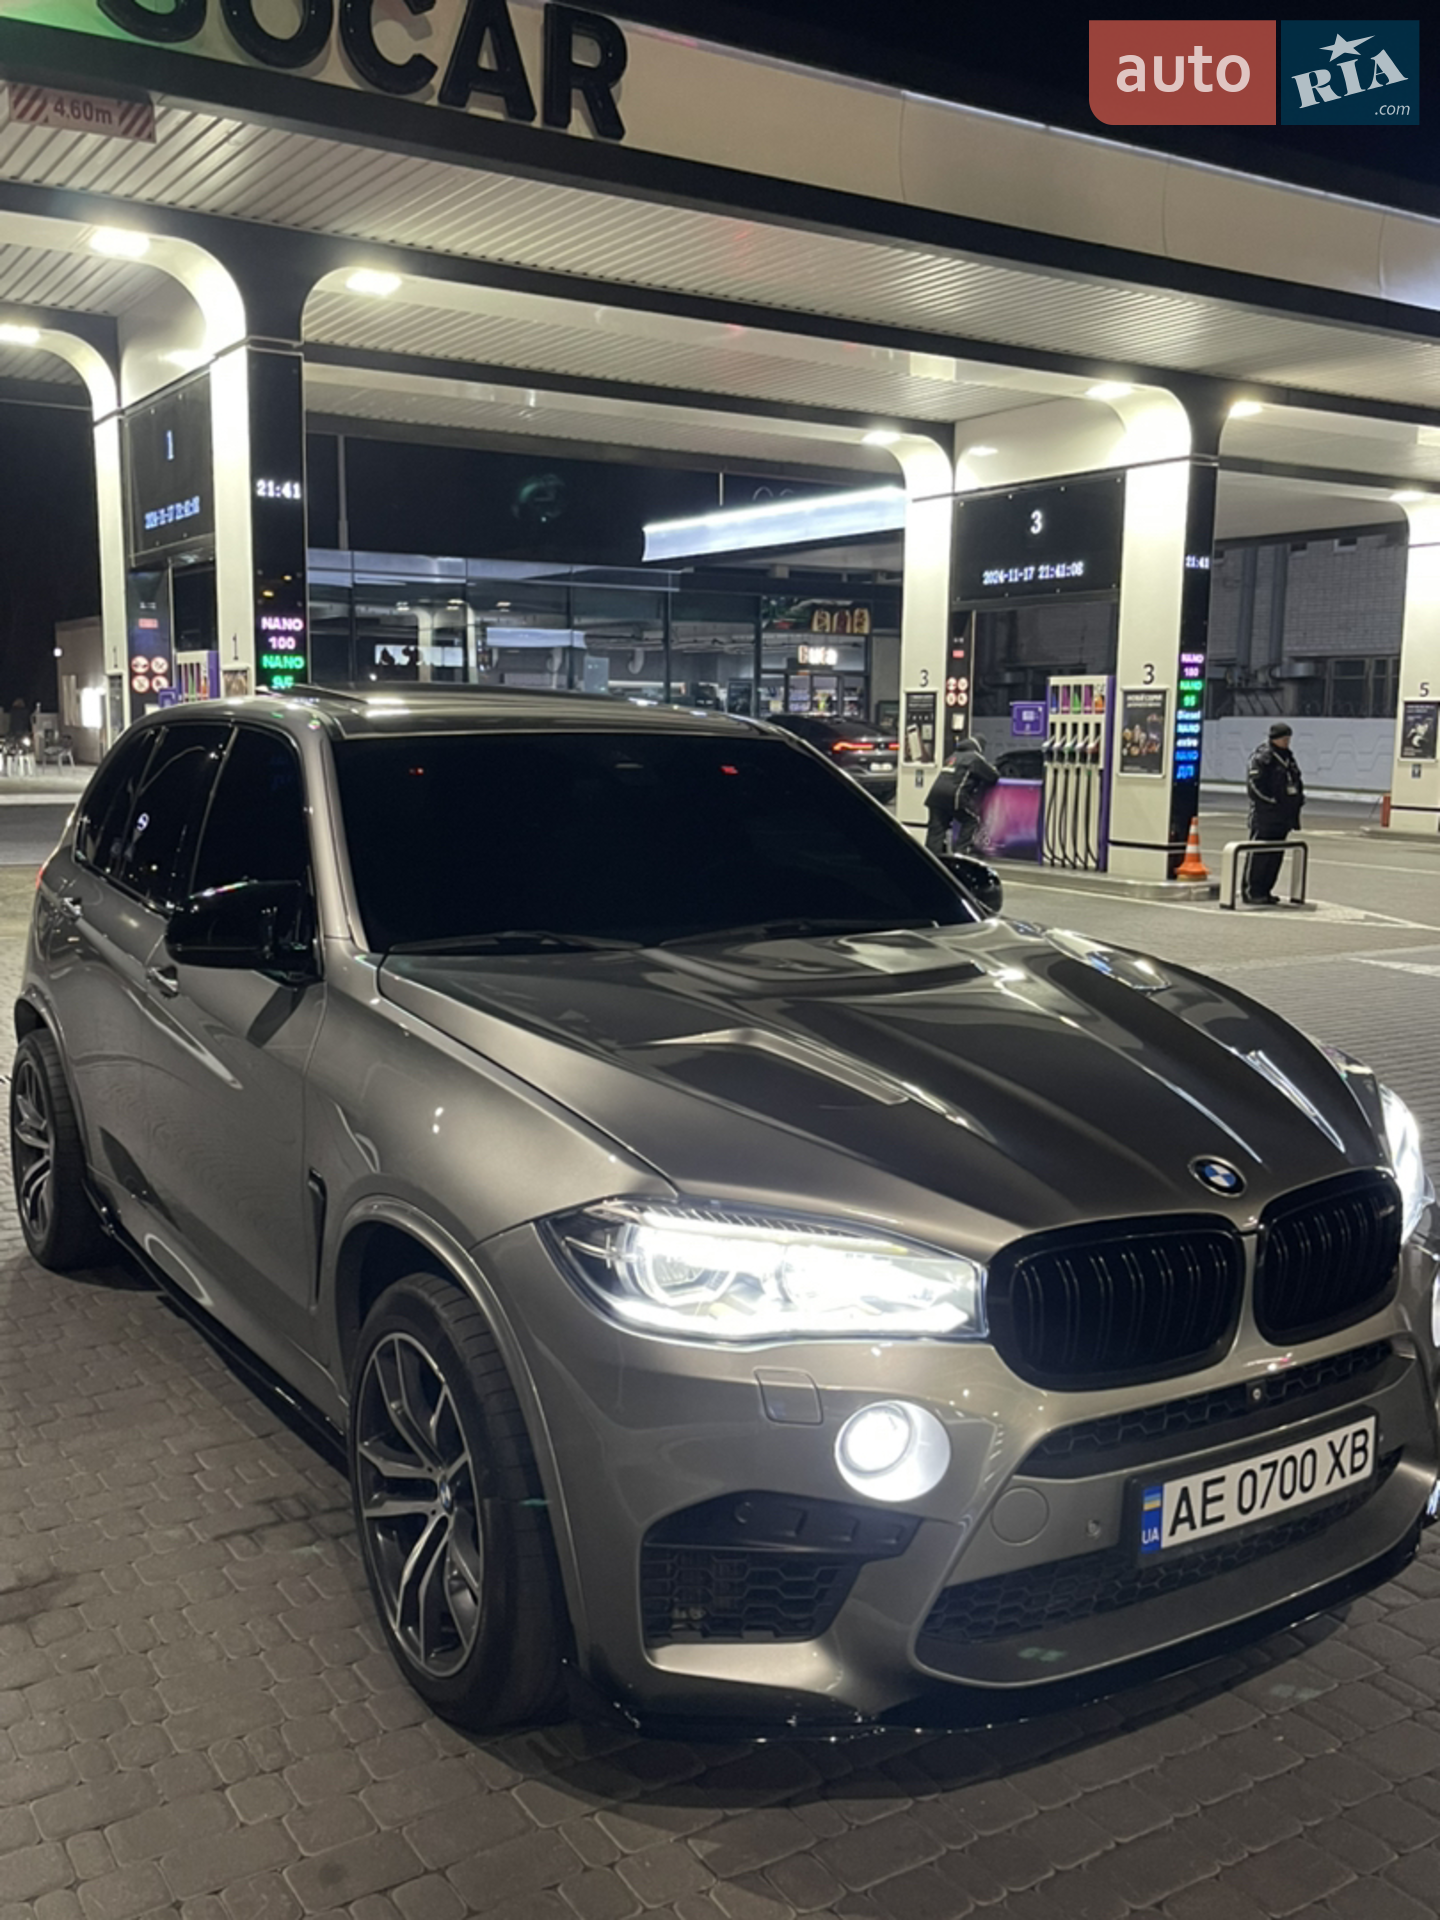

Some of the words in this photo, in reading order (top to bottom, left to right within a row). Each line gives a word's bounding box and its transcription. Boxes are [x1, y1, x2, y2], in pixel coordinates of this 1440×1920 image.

[53, 96, 113, 125] 4.60m
[256, 479, 302, 499] 21:41
[1030, 509, 1043, 535] 3
[261, 617, 304, 631] NANO
[268, 636, 296, 650] 100
[262, 655, 305, 669] NANO
[920, 670, 929, 687] 3
[1142, 663, 1155, 685] 3
[1420, 682, 1430, 697] 5
[1168, 1476, 1226, 1537] AE
[1237, 1447, 1317, 1516] 0700
[1325, 1428, 1370, 1486] XB
[1141, 1528, 1160, 1544] UA
